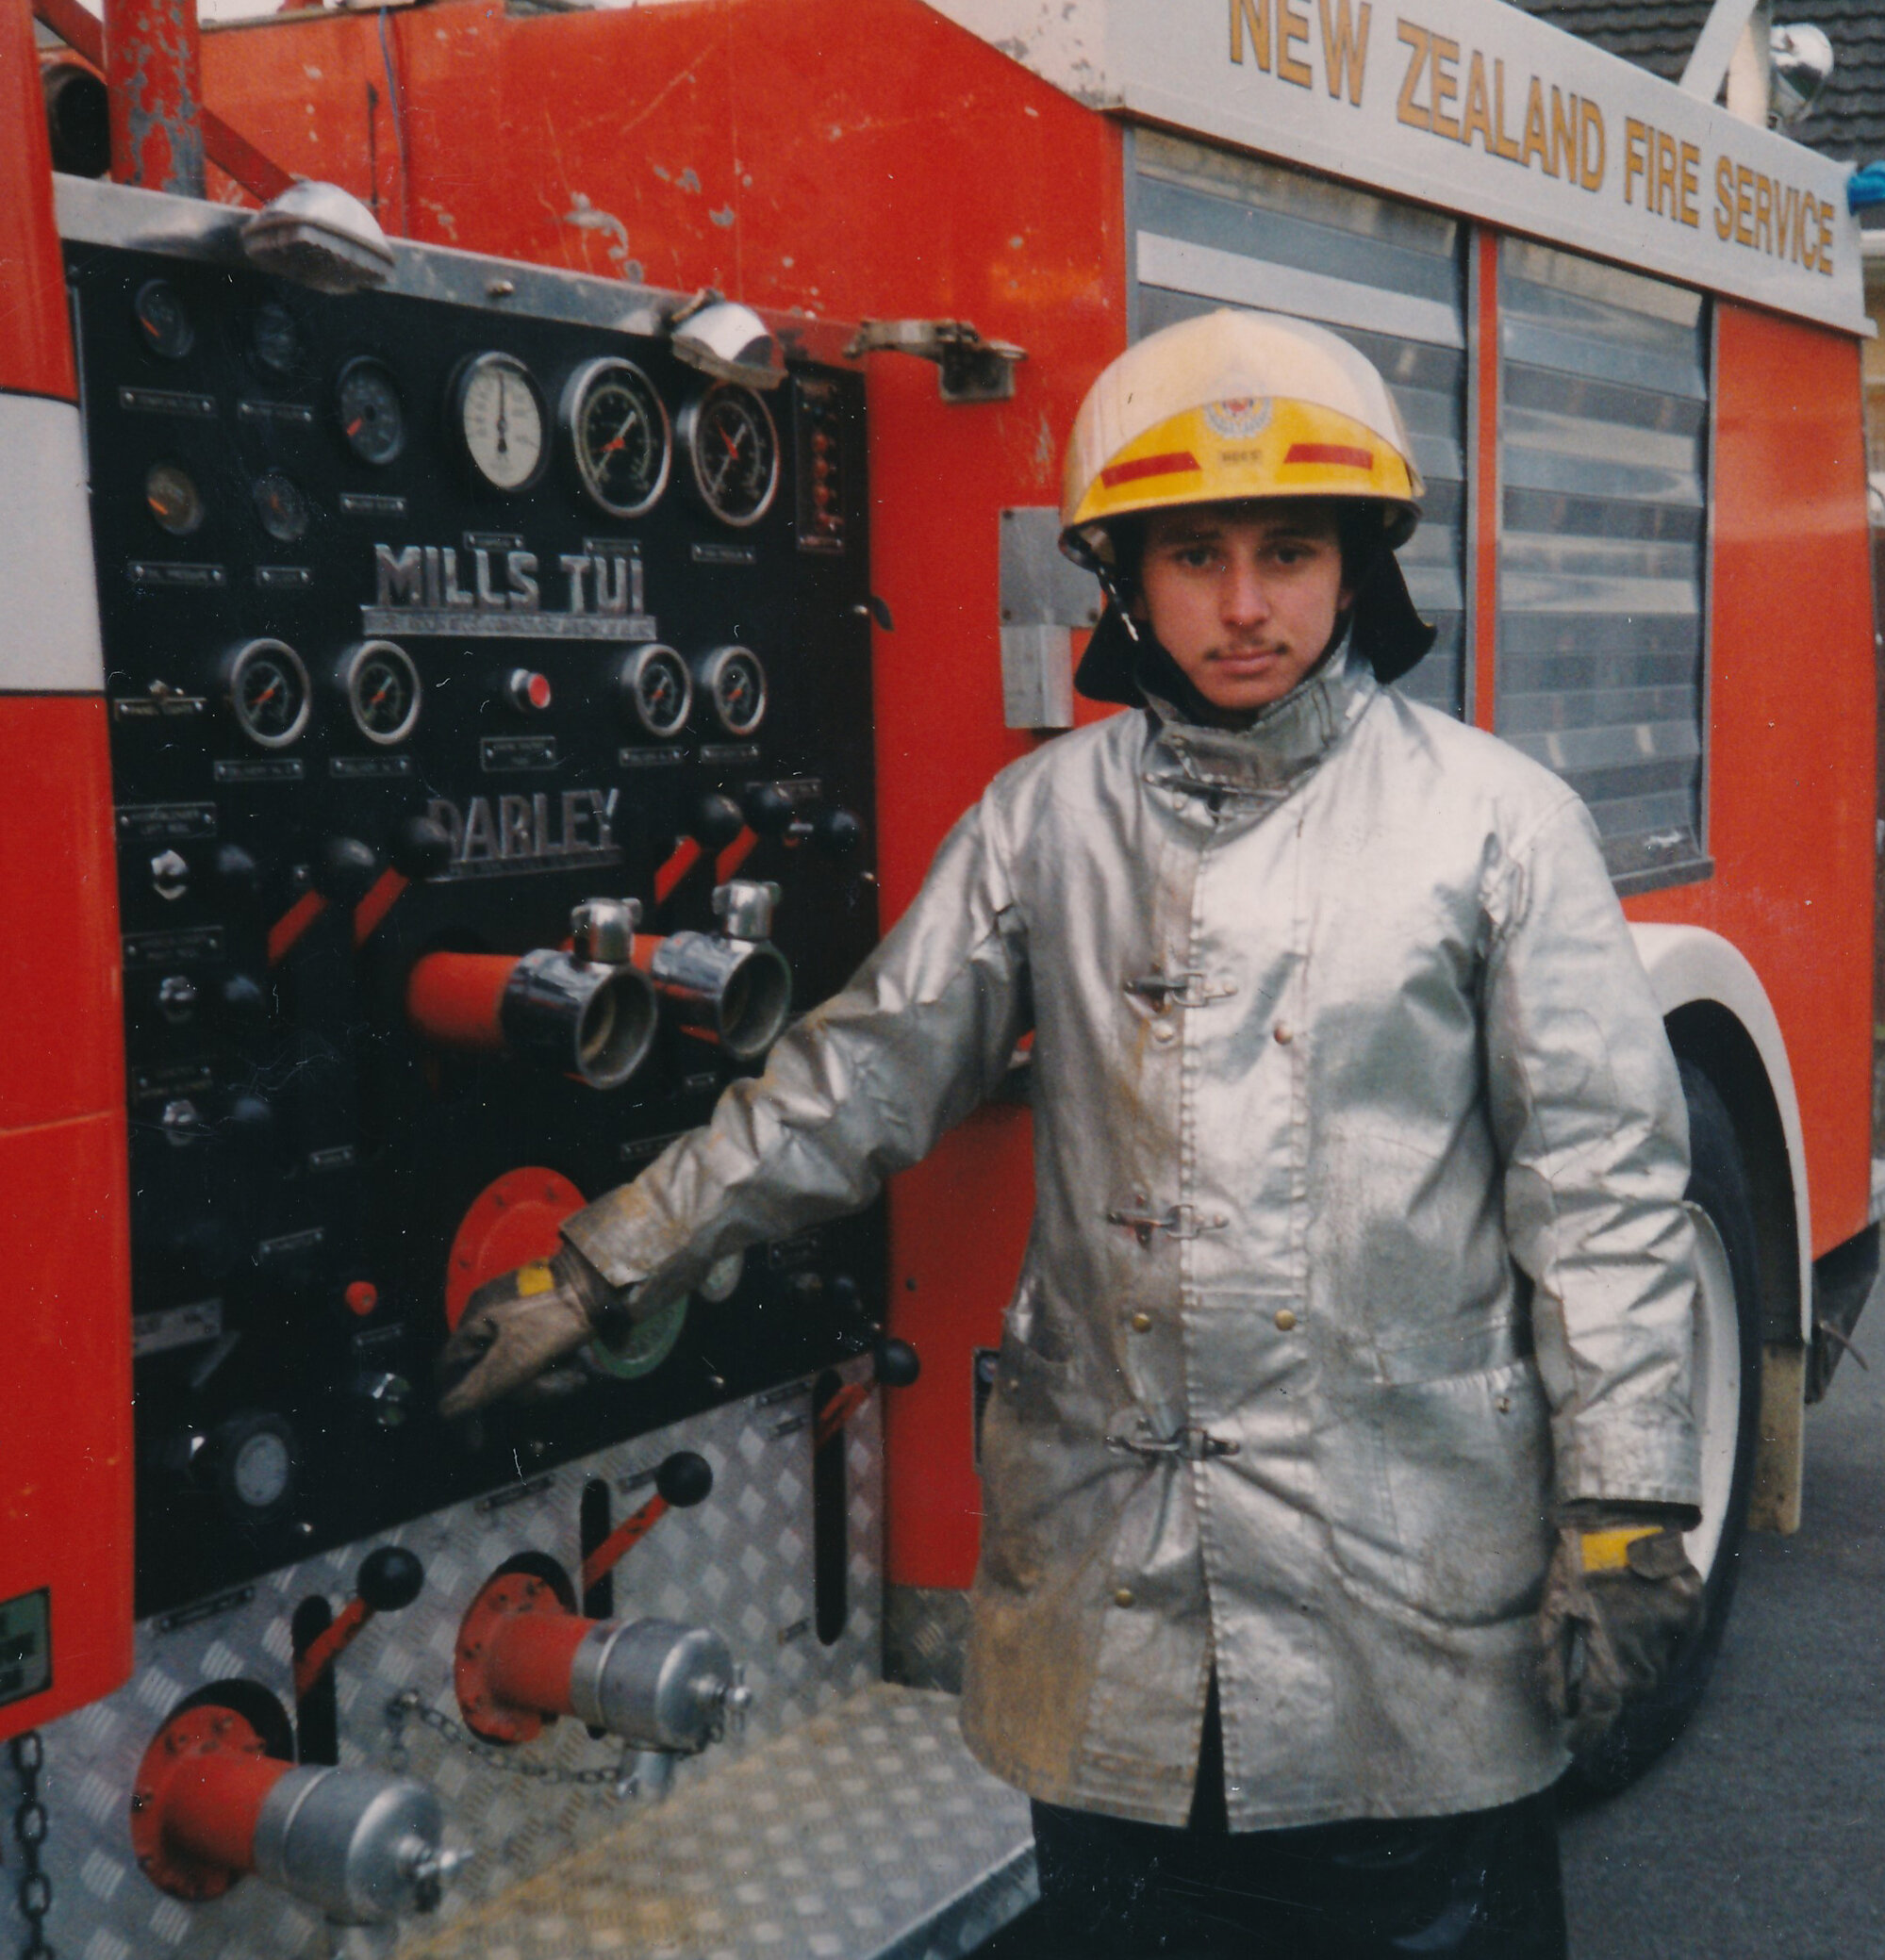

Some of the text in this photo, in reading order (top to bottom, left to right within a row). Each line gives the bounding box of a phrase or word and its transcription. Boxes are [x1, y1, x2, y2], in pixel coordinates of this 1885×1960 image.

[1229, 0, 1835, 276] NEW ZEALAND FIRE SERVICE
[374, 543, 644, 617] MILLS TUI
[426, 787, 620, 863] DARLEY
